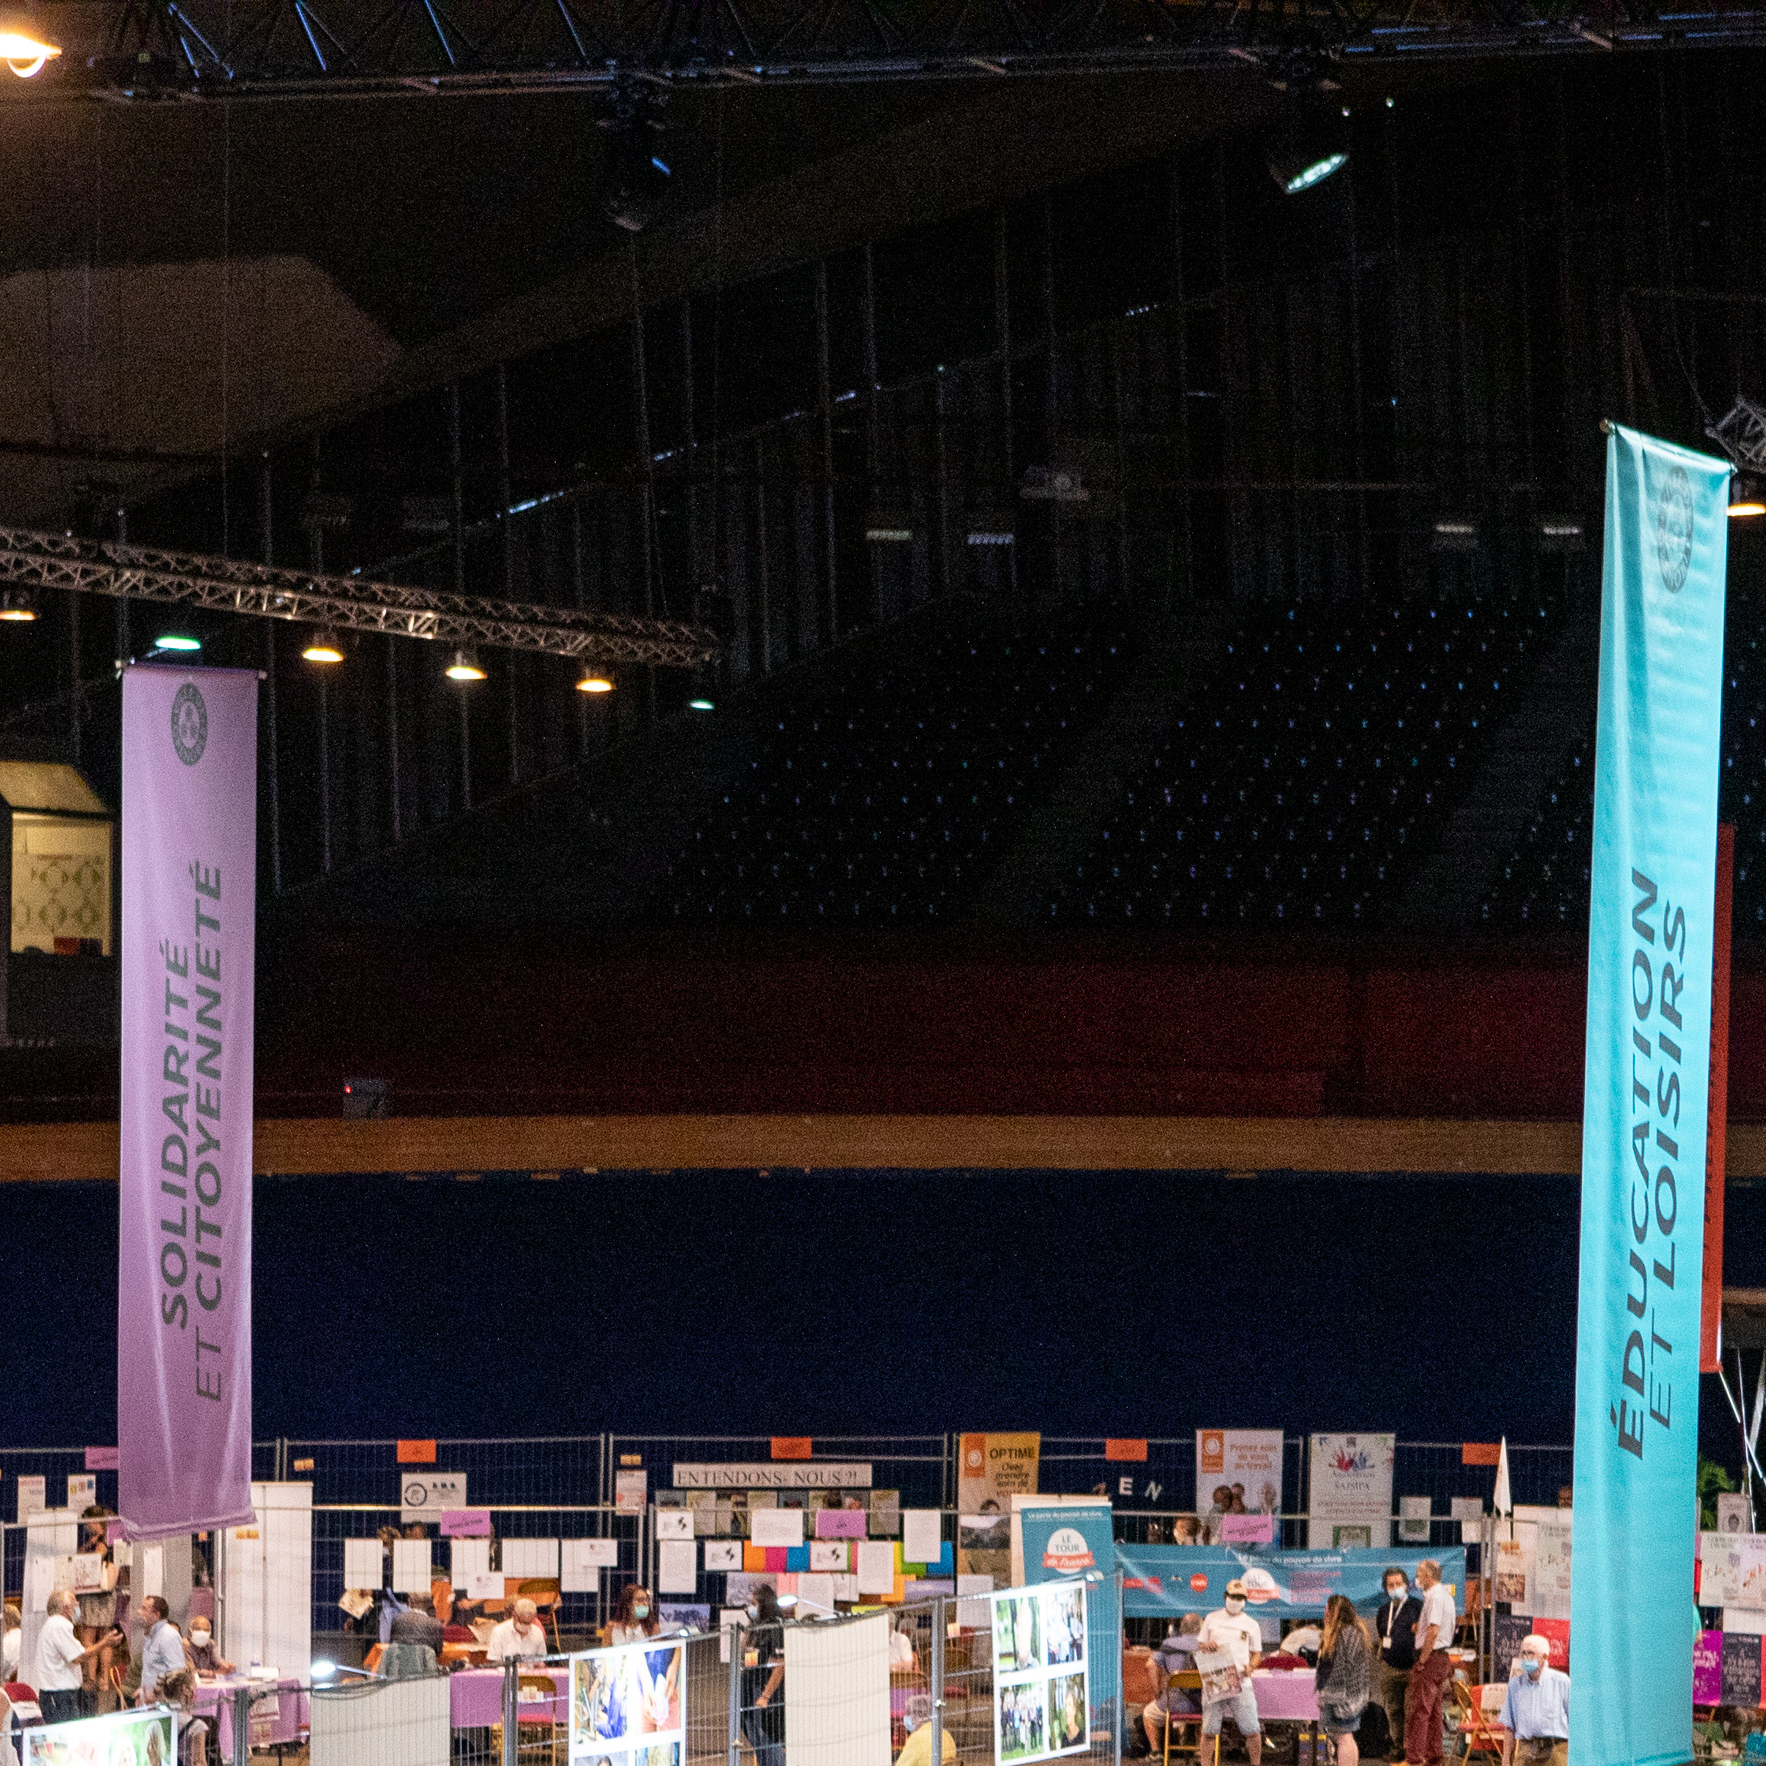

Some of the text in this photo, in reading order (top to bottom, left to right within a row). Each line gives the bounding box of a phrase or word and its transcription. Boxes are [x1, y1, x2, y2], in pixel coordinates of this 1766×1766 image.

[158, 937, 189, 1331] SOLIDARITÉ
[189, 859, 222, 1401] ET CITOYENNETÉ
[1610, 866, 1657, 1460] ÉDUCATION
[1650, 899, 1685, 1429] ET LOISIRS
[794, 1469, 841, 1485] NOUS
[1054, 1544, 1080, 1553] TOUR
[1062, 1535, 1072, 1544] LE
